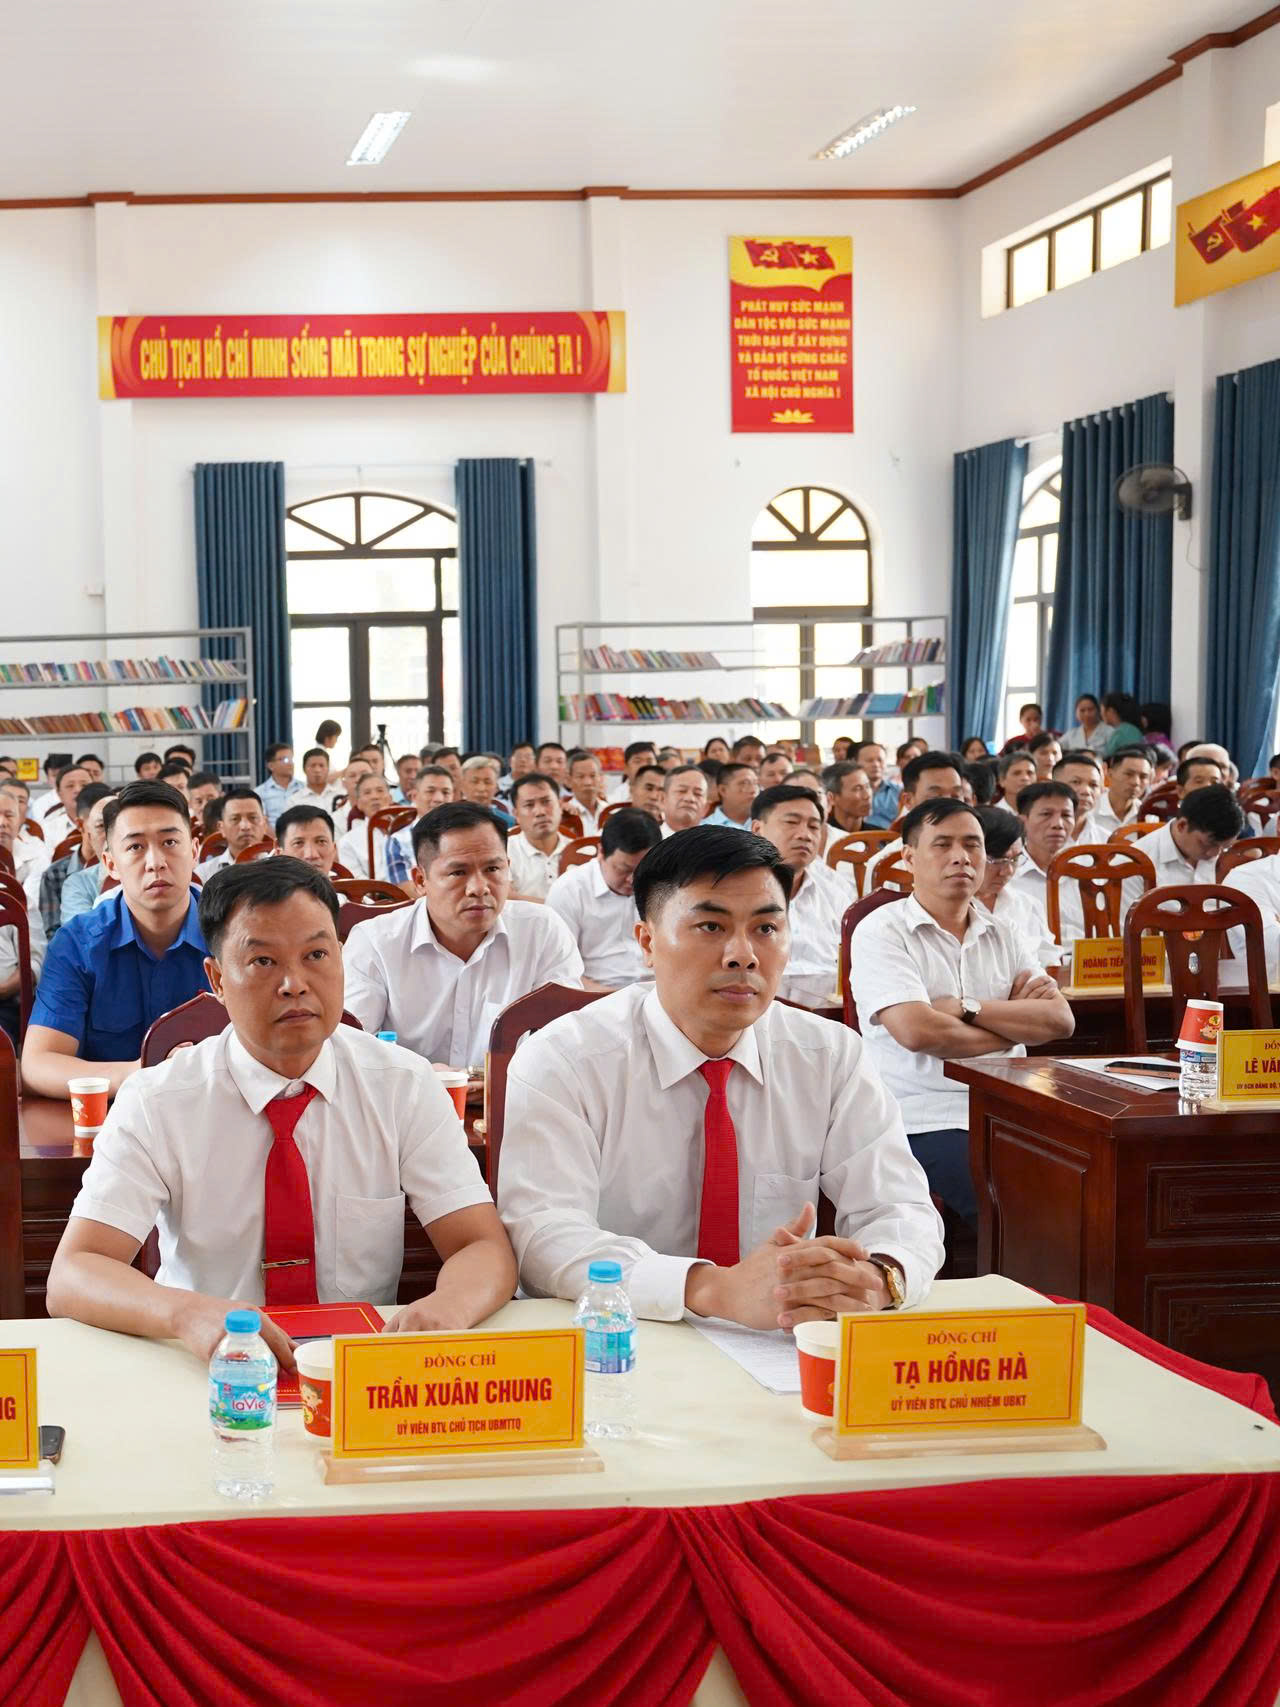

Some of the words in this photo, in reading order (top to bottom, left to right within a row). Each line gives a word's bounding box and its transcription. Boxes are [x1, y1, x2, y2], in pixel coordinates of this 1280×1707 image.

[741, 299, 767, 312] PHÁT
[768, 301, 789, 312] HUY
[140, 326, 167, 379] CHỦ
[170, 338, 201, 389] TỊCH
[226, 329, 249, 378] CHÍ
[252, 337, 288, 378] MINH
[291, 323, 328, 378] SỐNG
[331, 329, 358, 378] MÃI
[360, 336, 405, 377] TRONG
[407, 331, 428, 385] SỰ
[428, 327, 478, 385] NGHIỆP
[480, 322, 508, 376] CỦA
[510, 326, 556, 376] CHÚNG
[558, 334, 573, 375] TA
[791, 368, 813, 383] VIỆT
[814, 369, 838, 381] NAM
[1245, 1058, 1258, 1073] LÊ
[927, 1331, 967, 1345] ĐỒNG
[971, 1328, 997, 1344] CHÍ
[424, 1354, 466, 1369] ĐỒNG
[470, 1350, 496, 1366] CHÍ
[893, 1360, 920, 1389] TẠ
[928, 1350, 990, 1384] HỒNG
[998, 1352, 1028, 1381] HÀ
[366, 1376, 419, 1410] TRẦN
[424, 1377, 478, 1407] XUÂN
[485, 1377, 552, 1405] CHUNG
[906, 1396, 926, 1410] VIÊN
[950, 1394, 968, 1408] CHỦ
[971, 1394, 1001, 1410] NHIỆM
[1003, 1395, 1026, 1407] UBKT
[410, 1420, 429, 1434] VIÊN
[449, 1417, 466, 1432] CHỦ
[468, 1420, 486, 1434] TỊCH
[488, 1418, 521, 1431] UBMTTQ
